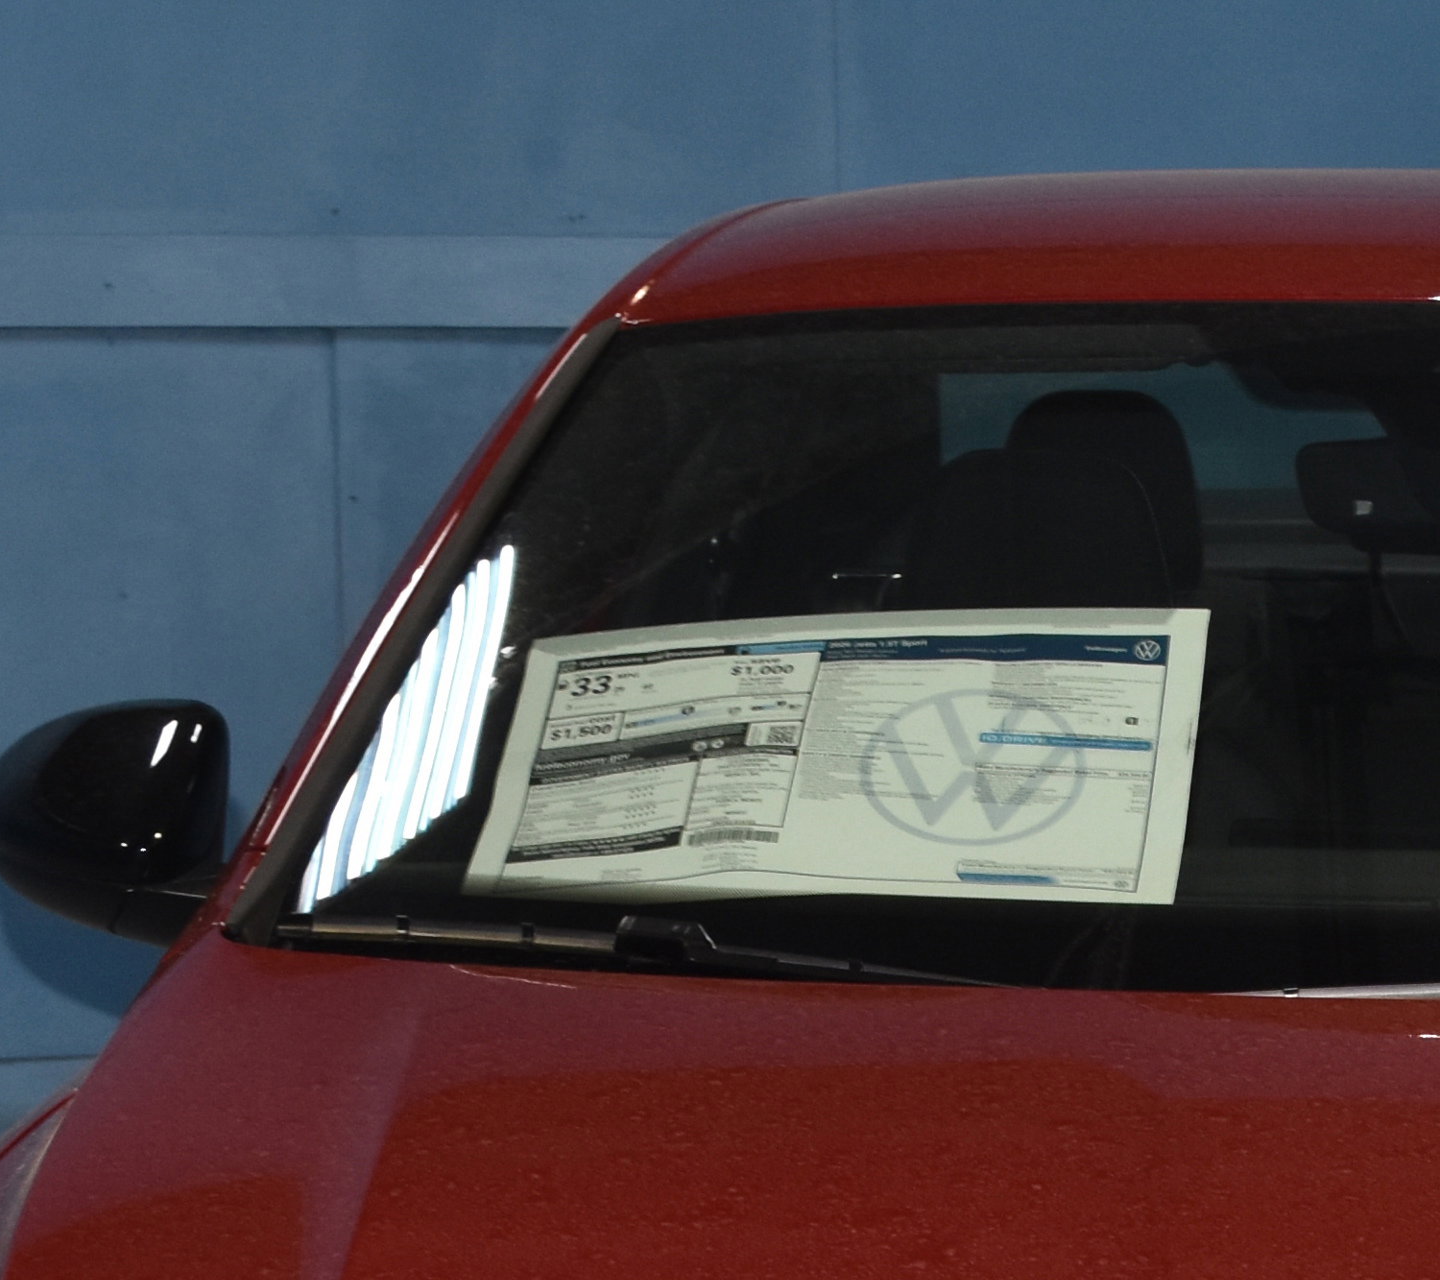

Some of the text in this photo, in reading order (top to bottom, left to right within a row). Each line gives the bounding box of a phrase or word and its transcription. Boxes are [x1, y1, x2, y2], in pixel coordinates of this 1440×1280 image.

[730, 664, 795, 676] $1,000
[570, 675, 613, 697] 33
[550, 724, 613, 742] $1,500
